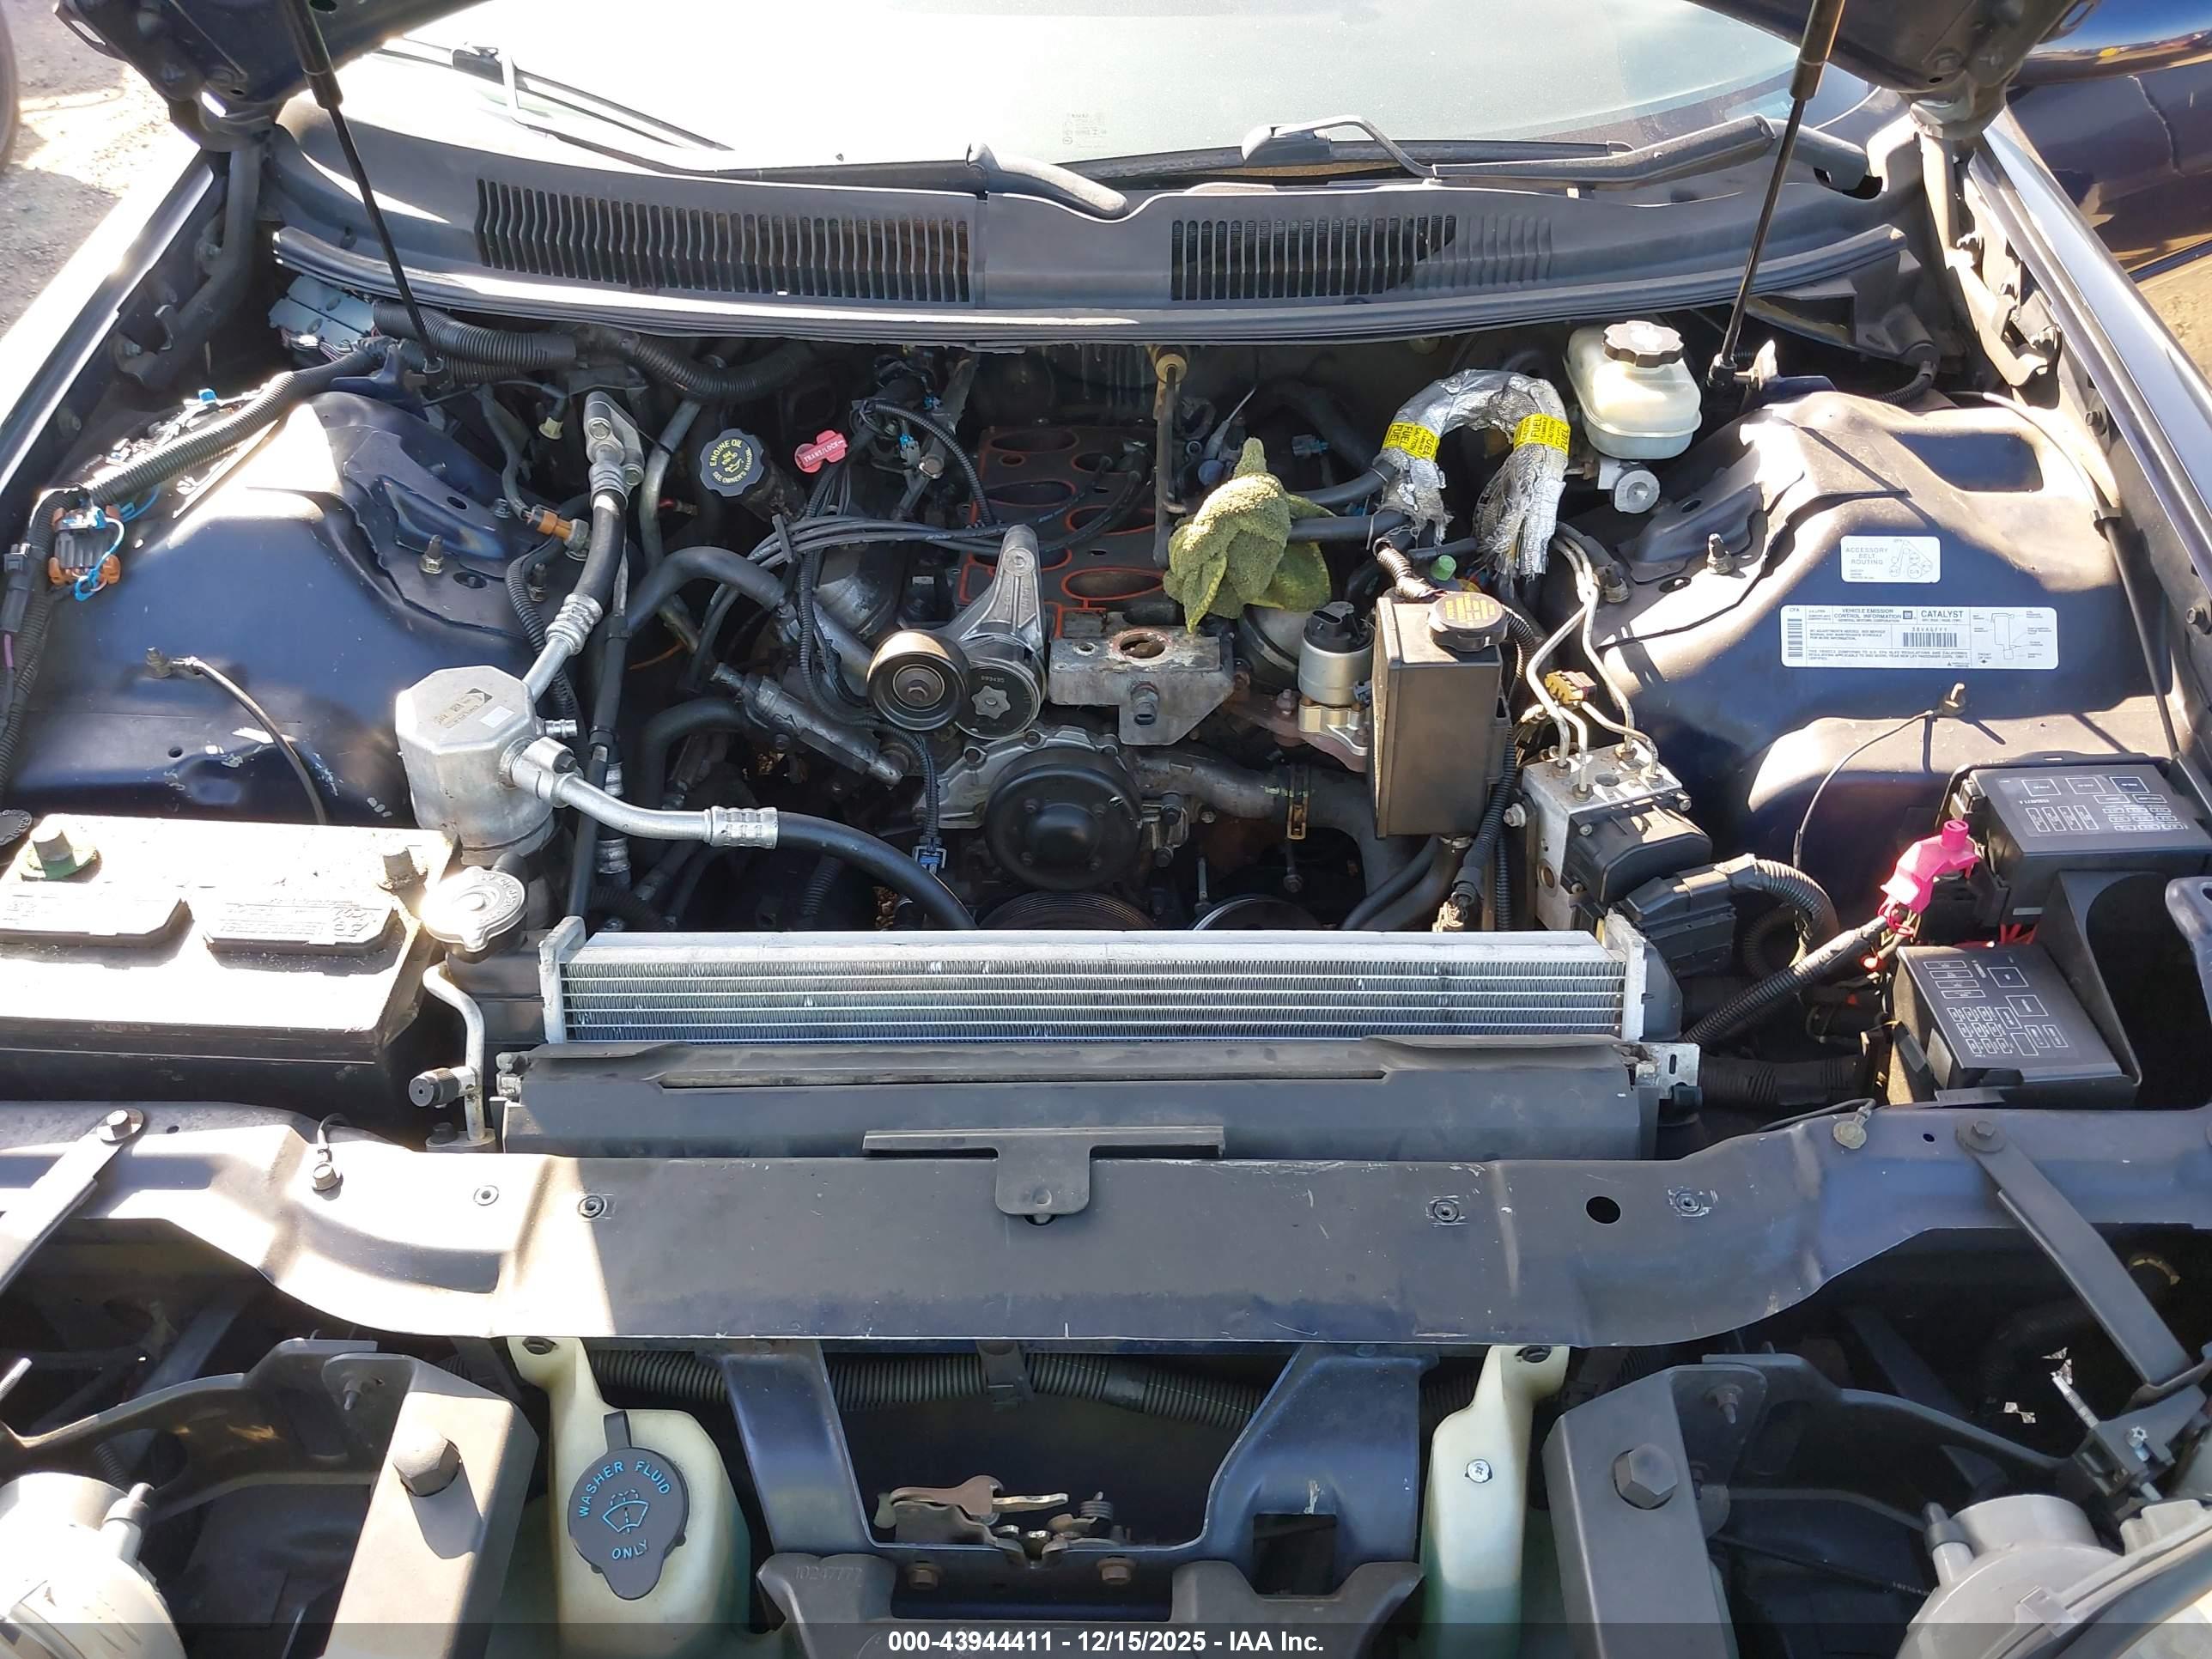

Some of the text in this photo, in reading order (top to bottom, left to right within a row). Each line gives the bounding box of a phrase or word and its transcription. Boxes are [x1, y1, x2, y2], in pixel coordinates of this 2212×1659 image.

[1531, 417, 1542, 439] FUEL
[709, 439, 743, 467] ENGINE OIL
[578, 1461, 672, 1518] WASHER FLUID
[611, 1540, 648, 1560] ONLY
